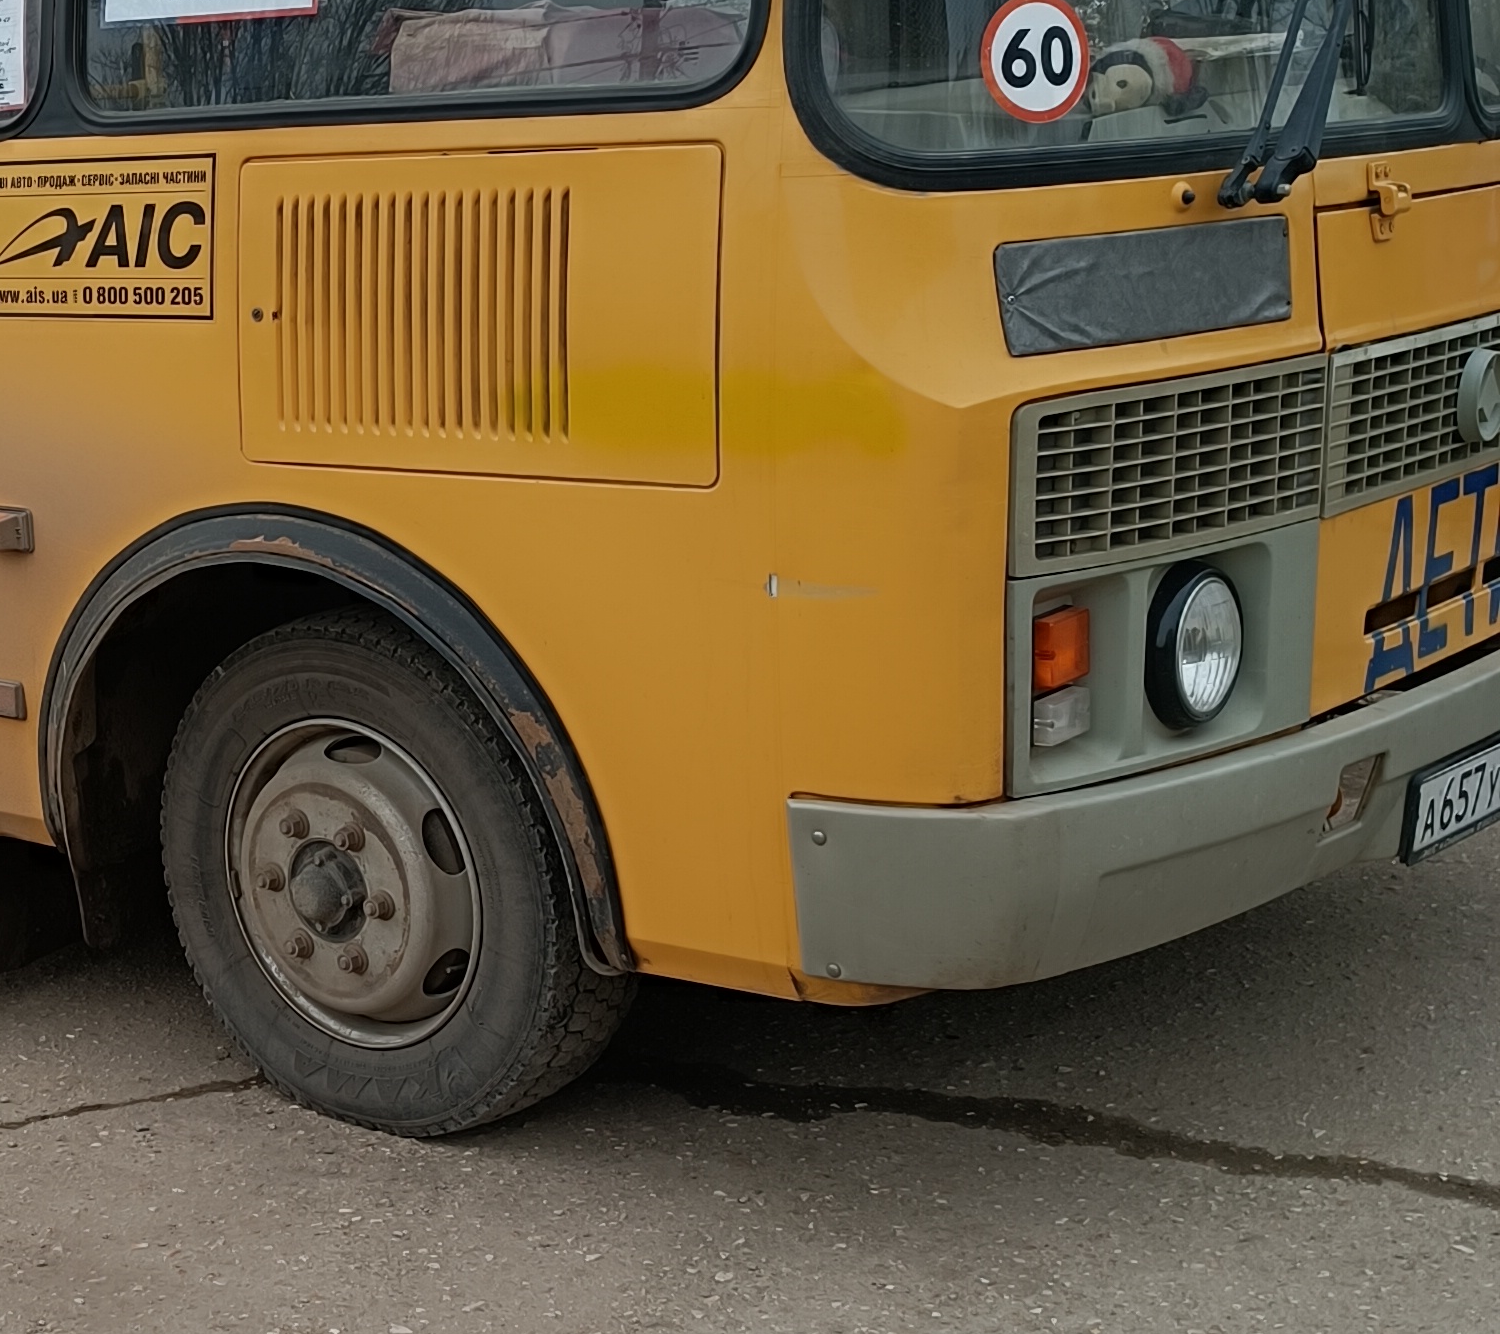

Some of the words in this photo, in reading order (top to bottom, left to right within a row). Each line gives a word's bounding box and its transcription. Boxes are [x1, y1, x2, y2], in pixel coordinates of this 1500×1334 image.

[1001, 25, 1073, 88] 60
[10, 175, 33, 189] АВТО
[37, 174, 77, 189] ПРОДАЖ
[119, 171, 159, 186] ЗАПАСНІ
[162, 170, 207, 185] ЧАСТИНИ
[82, 286, 93, 304] 0
[96, 286, 128, 305] 800
[133, 286, 166, 305] 500
[170, 286, 204, 305] 205
[1364, 463, 1500, 694] ДЕТ
[1420, 762, 1500, 843] А657У
